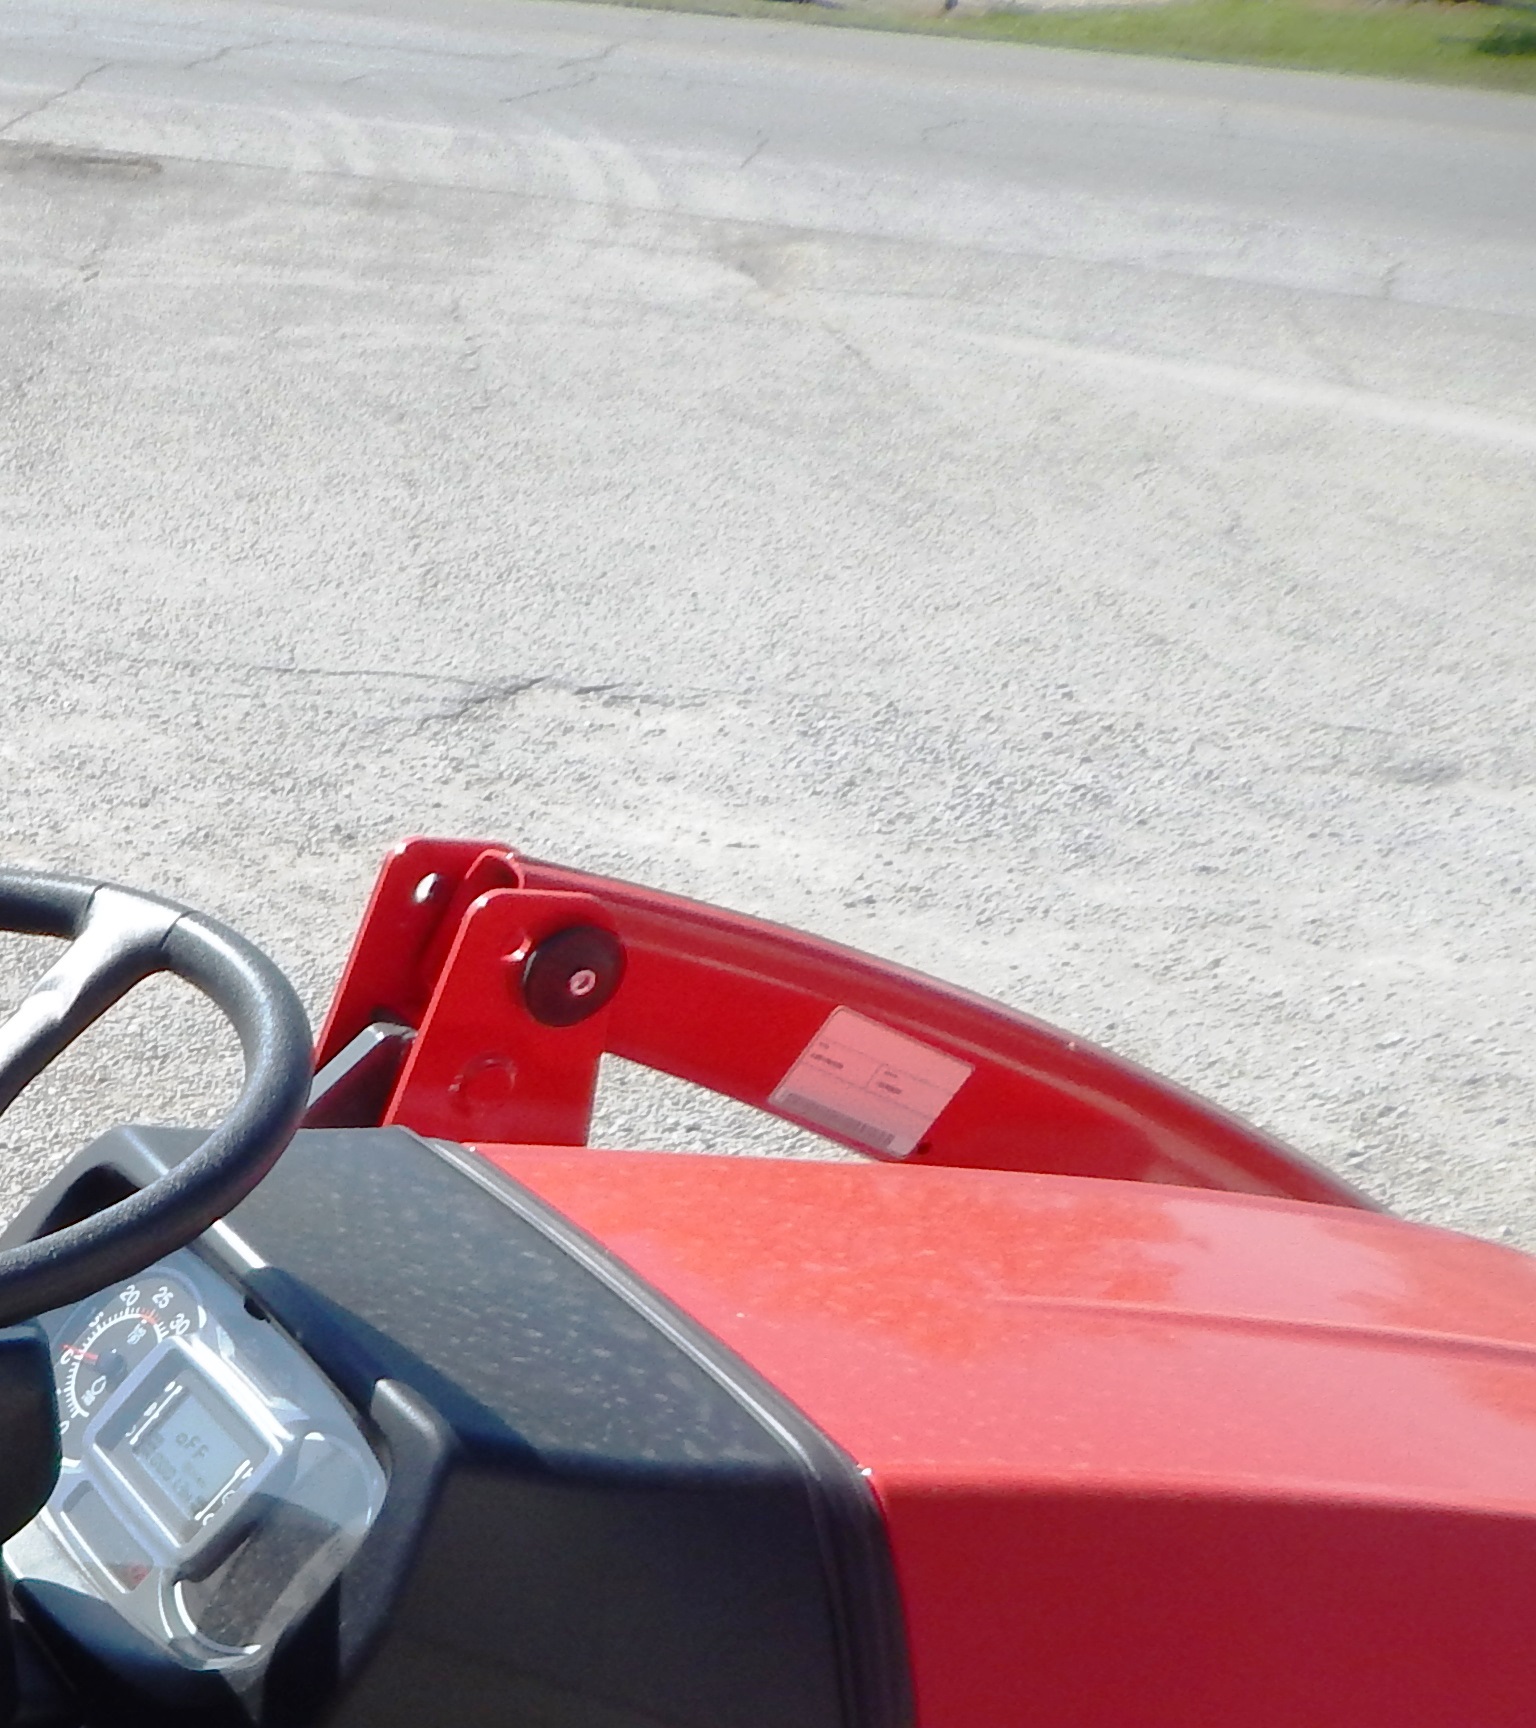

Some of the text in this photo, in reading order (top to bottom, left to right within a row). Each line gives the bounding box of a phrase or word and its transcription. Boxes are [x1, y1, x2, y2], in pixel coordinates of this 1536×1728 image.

[120, 1284, 140, 1307] 20
[152, 1286, 174, 1309] 25
[169, 1312, 190, 1336] 30
